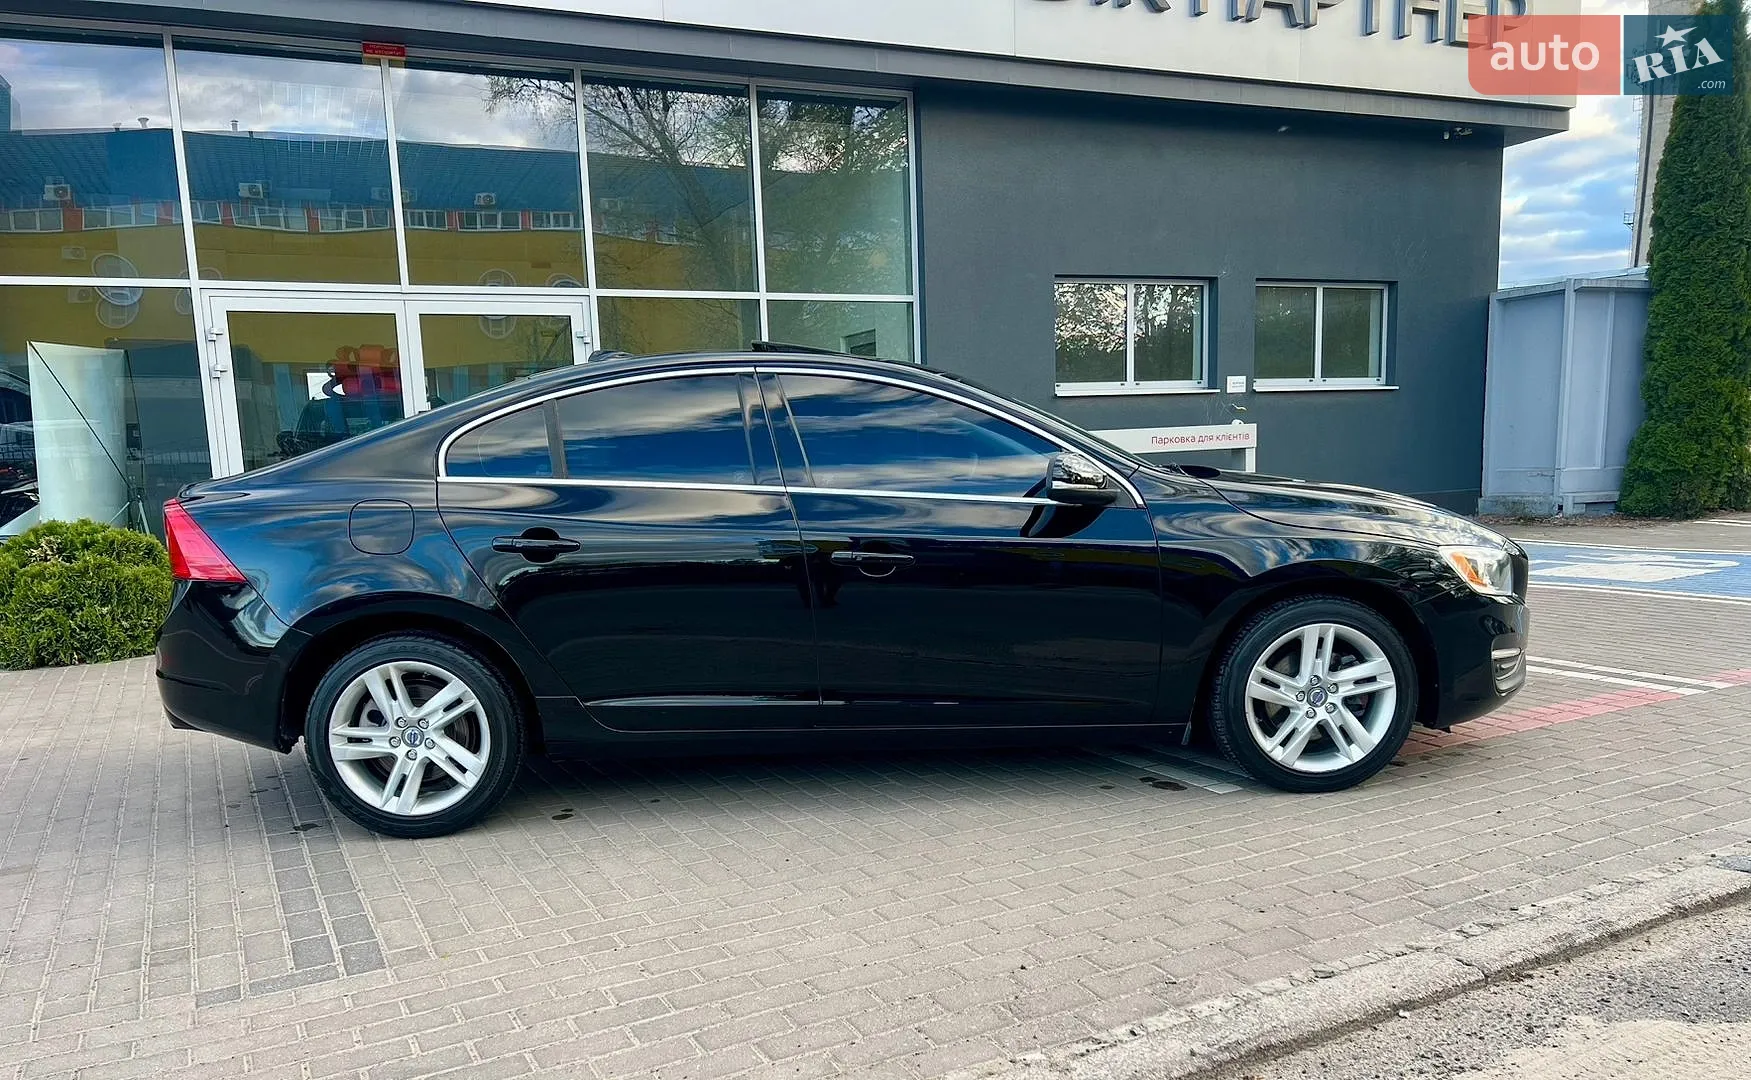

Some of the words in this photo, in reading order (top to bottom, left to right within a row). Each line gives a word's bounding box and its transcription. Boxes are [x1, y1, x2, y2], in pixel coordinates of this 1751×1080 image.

[1151, 435, 1196, 446] Парковка
[1198, 434, 1214, 443] для
[1216, 432, 1250, 441] клієнтів
